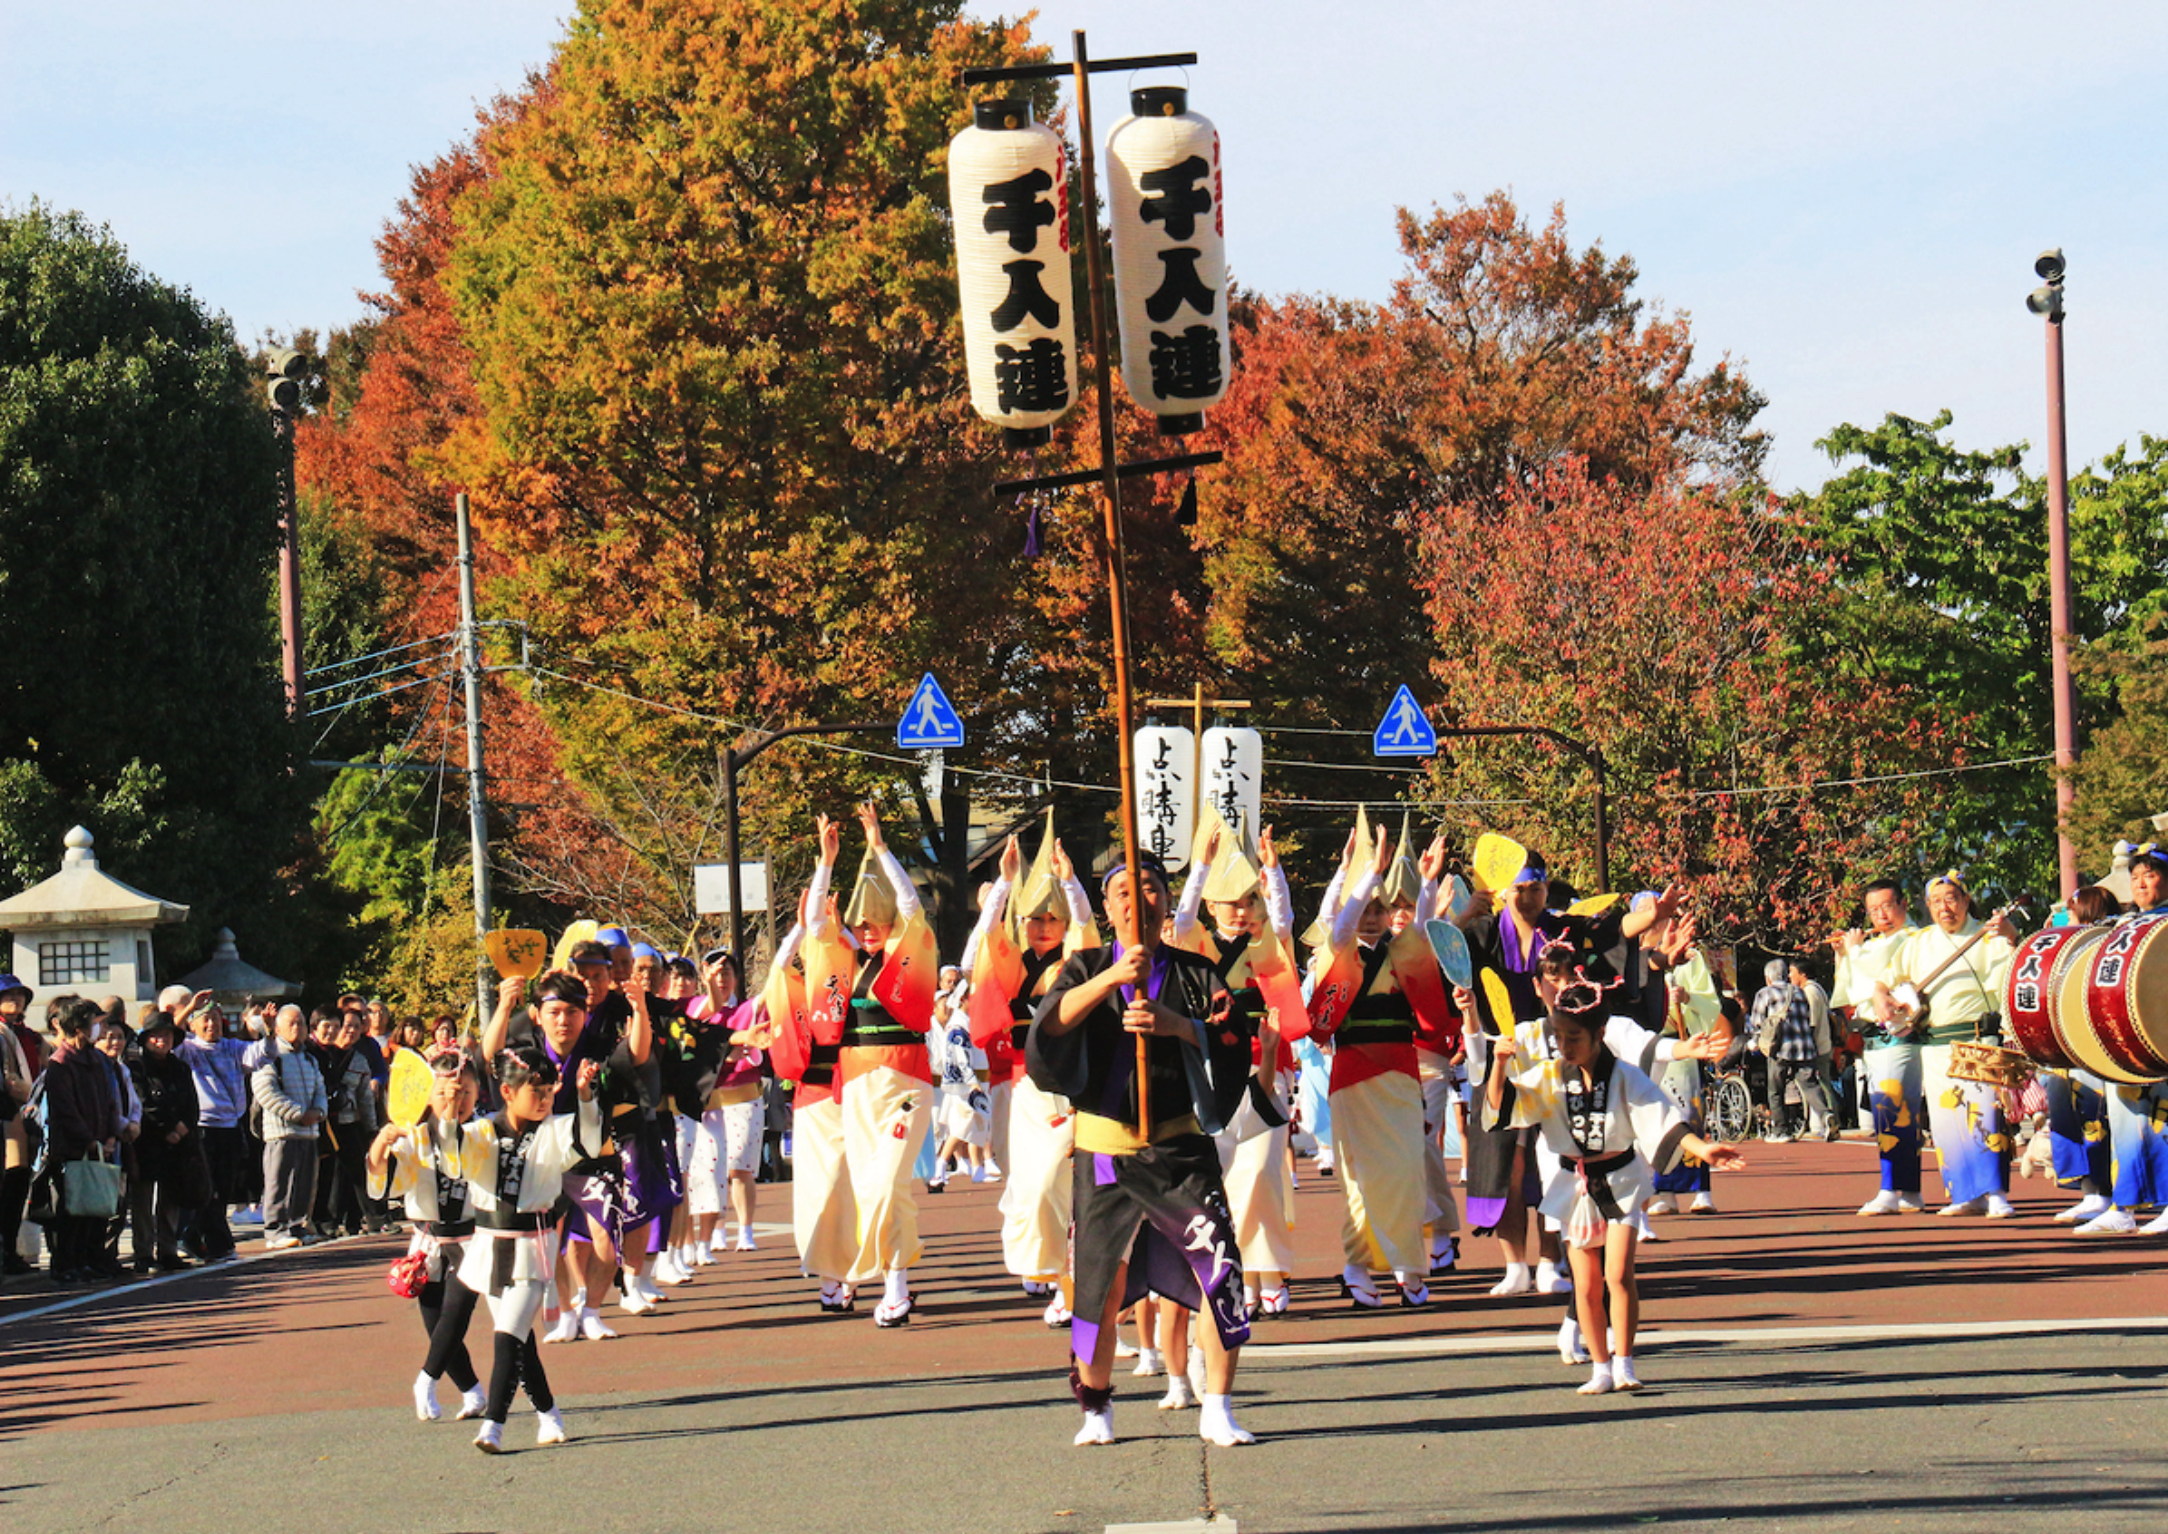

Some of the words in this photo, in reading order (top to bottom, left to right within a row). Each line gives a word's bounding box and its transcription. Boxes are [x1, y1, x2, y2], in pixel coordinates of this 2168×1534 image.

[982, 168, 1069, 415] 千人連
[1140, 155, 1222, 400] 千人連
[2015, 933, 2061, 1011] 千人連
